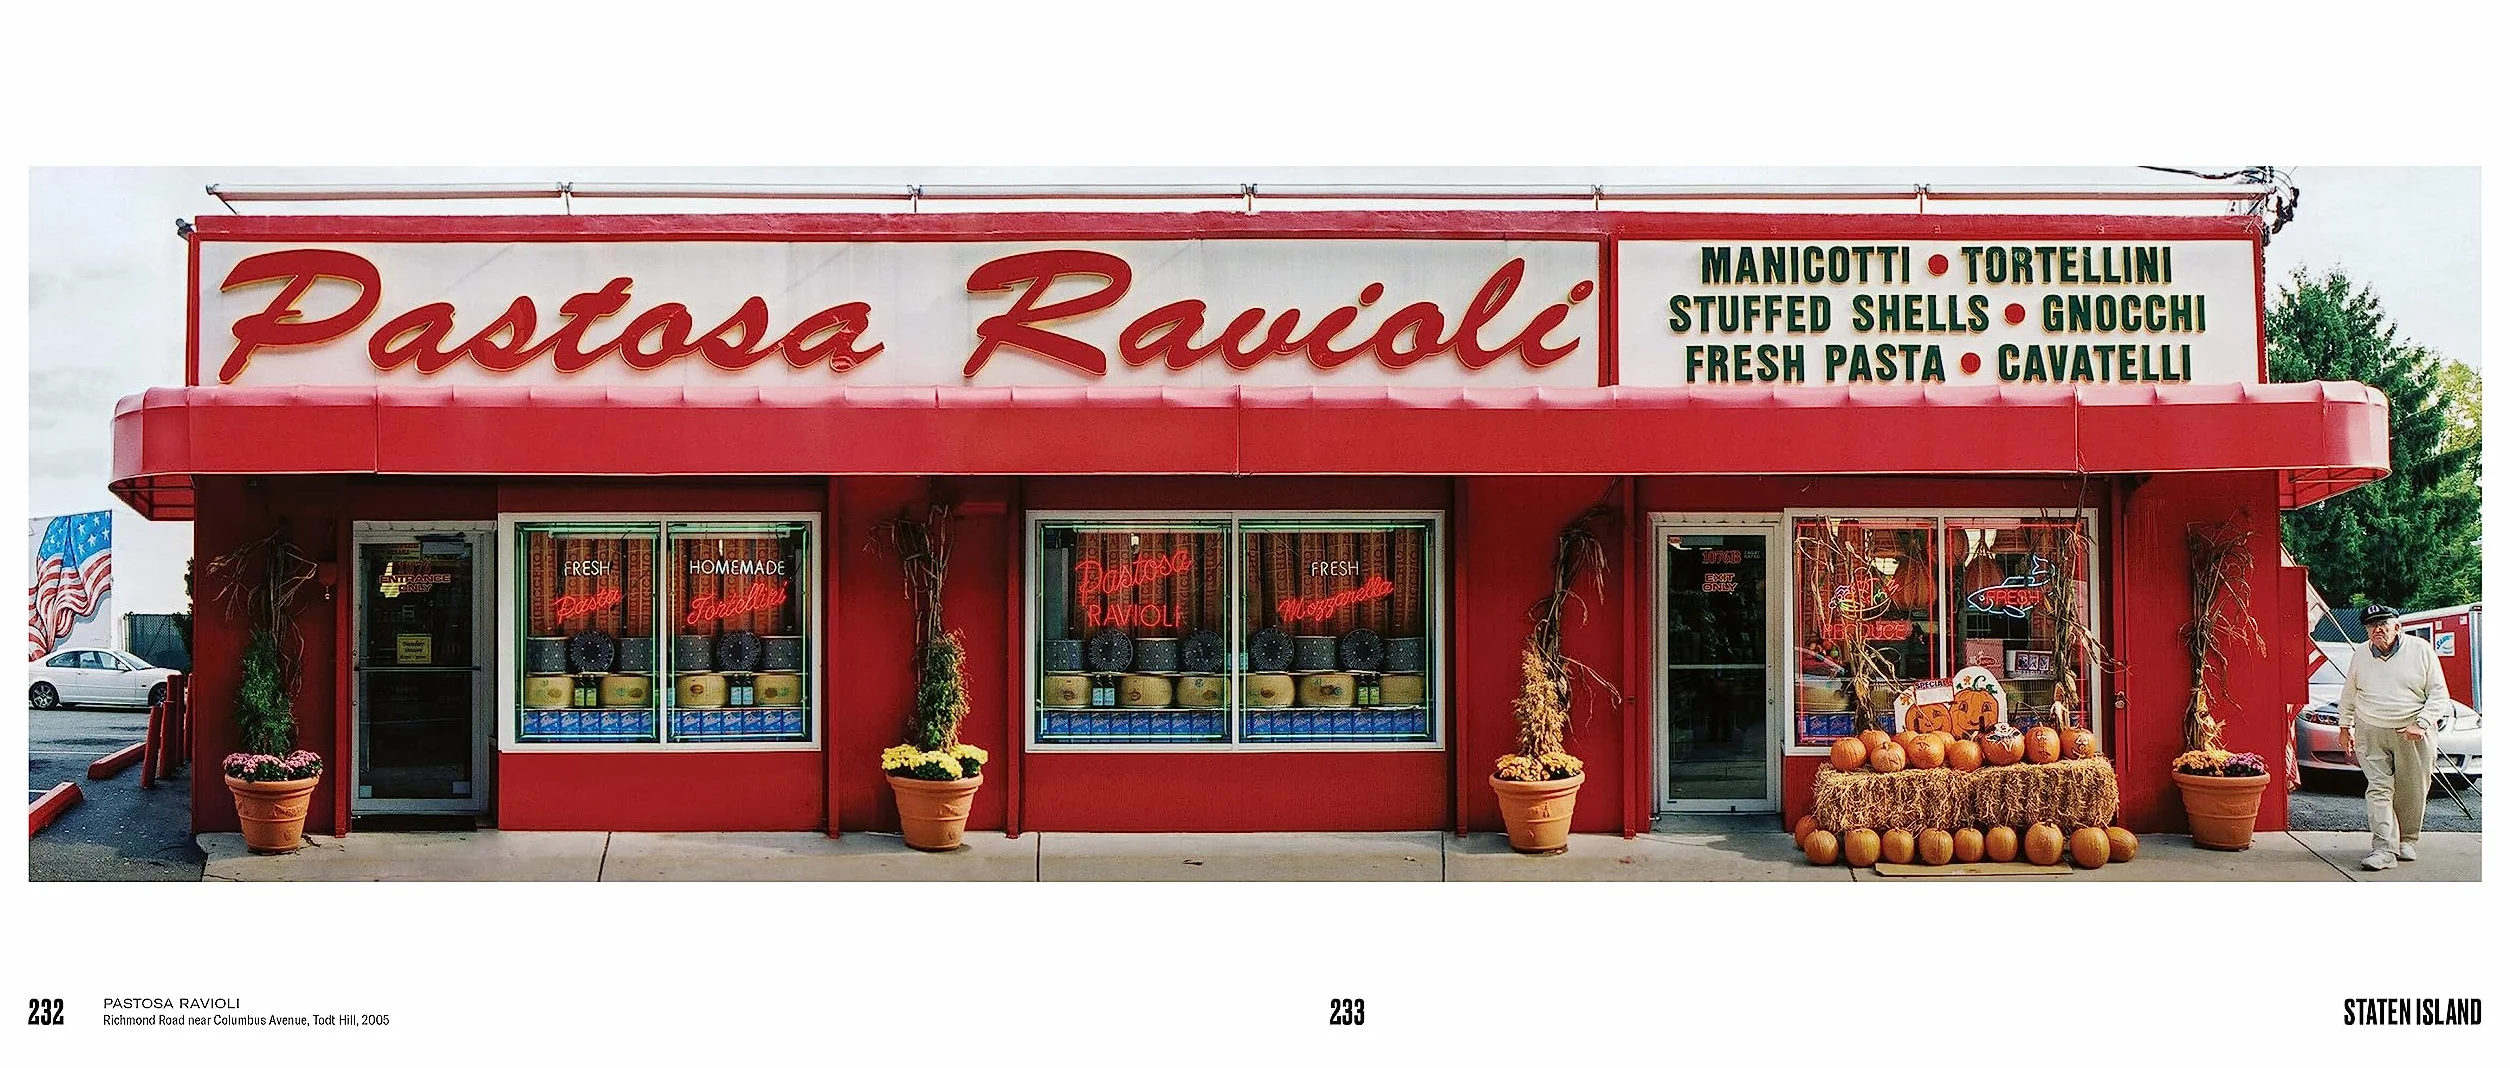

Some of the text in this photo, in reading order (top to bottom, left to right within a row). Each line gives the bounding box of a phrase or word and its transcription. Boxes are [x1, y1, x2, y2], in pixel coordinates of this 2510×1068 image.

[1701, 245, 2172, 285] MANICOTTI TORTELLINI
[217, 248, 1593, 383] Pastosa Ravioli
[1669, 294, 2206, 335] STUFFED SHELLS GNOCCHI
[1685, 343, 2192, 384] FRESH PASTA CAVATELLI
[1702, 550, 1742, 564] 1076B
[564, 560, 610, 576] FRESH
[689, 559, 786, 576] HOMEMADE
[1076, 550, 1193, 605] Pastosa
[1311, 561, 1359, 577] FRESH
[1705, 573, 1735, 582] EXIT
[379, 574, 452, 583] ENTRANCE
[399, 583, 433, 593] ONLY
[1702, 582, 1738, 592] ONLY
[555, 588, 622, 624] Pasta
[687, 580, 788, 625] Tortellini
[1278, 576, 1394, 623] Mozzarella
[1985, 590, 2040, 605] FRESH
[1087, 604, 1181, 627] RAVIOLI
